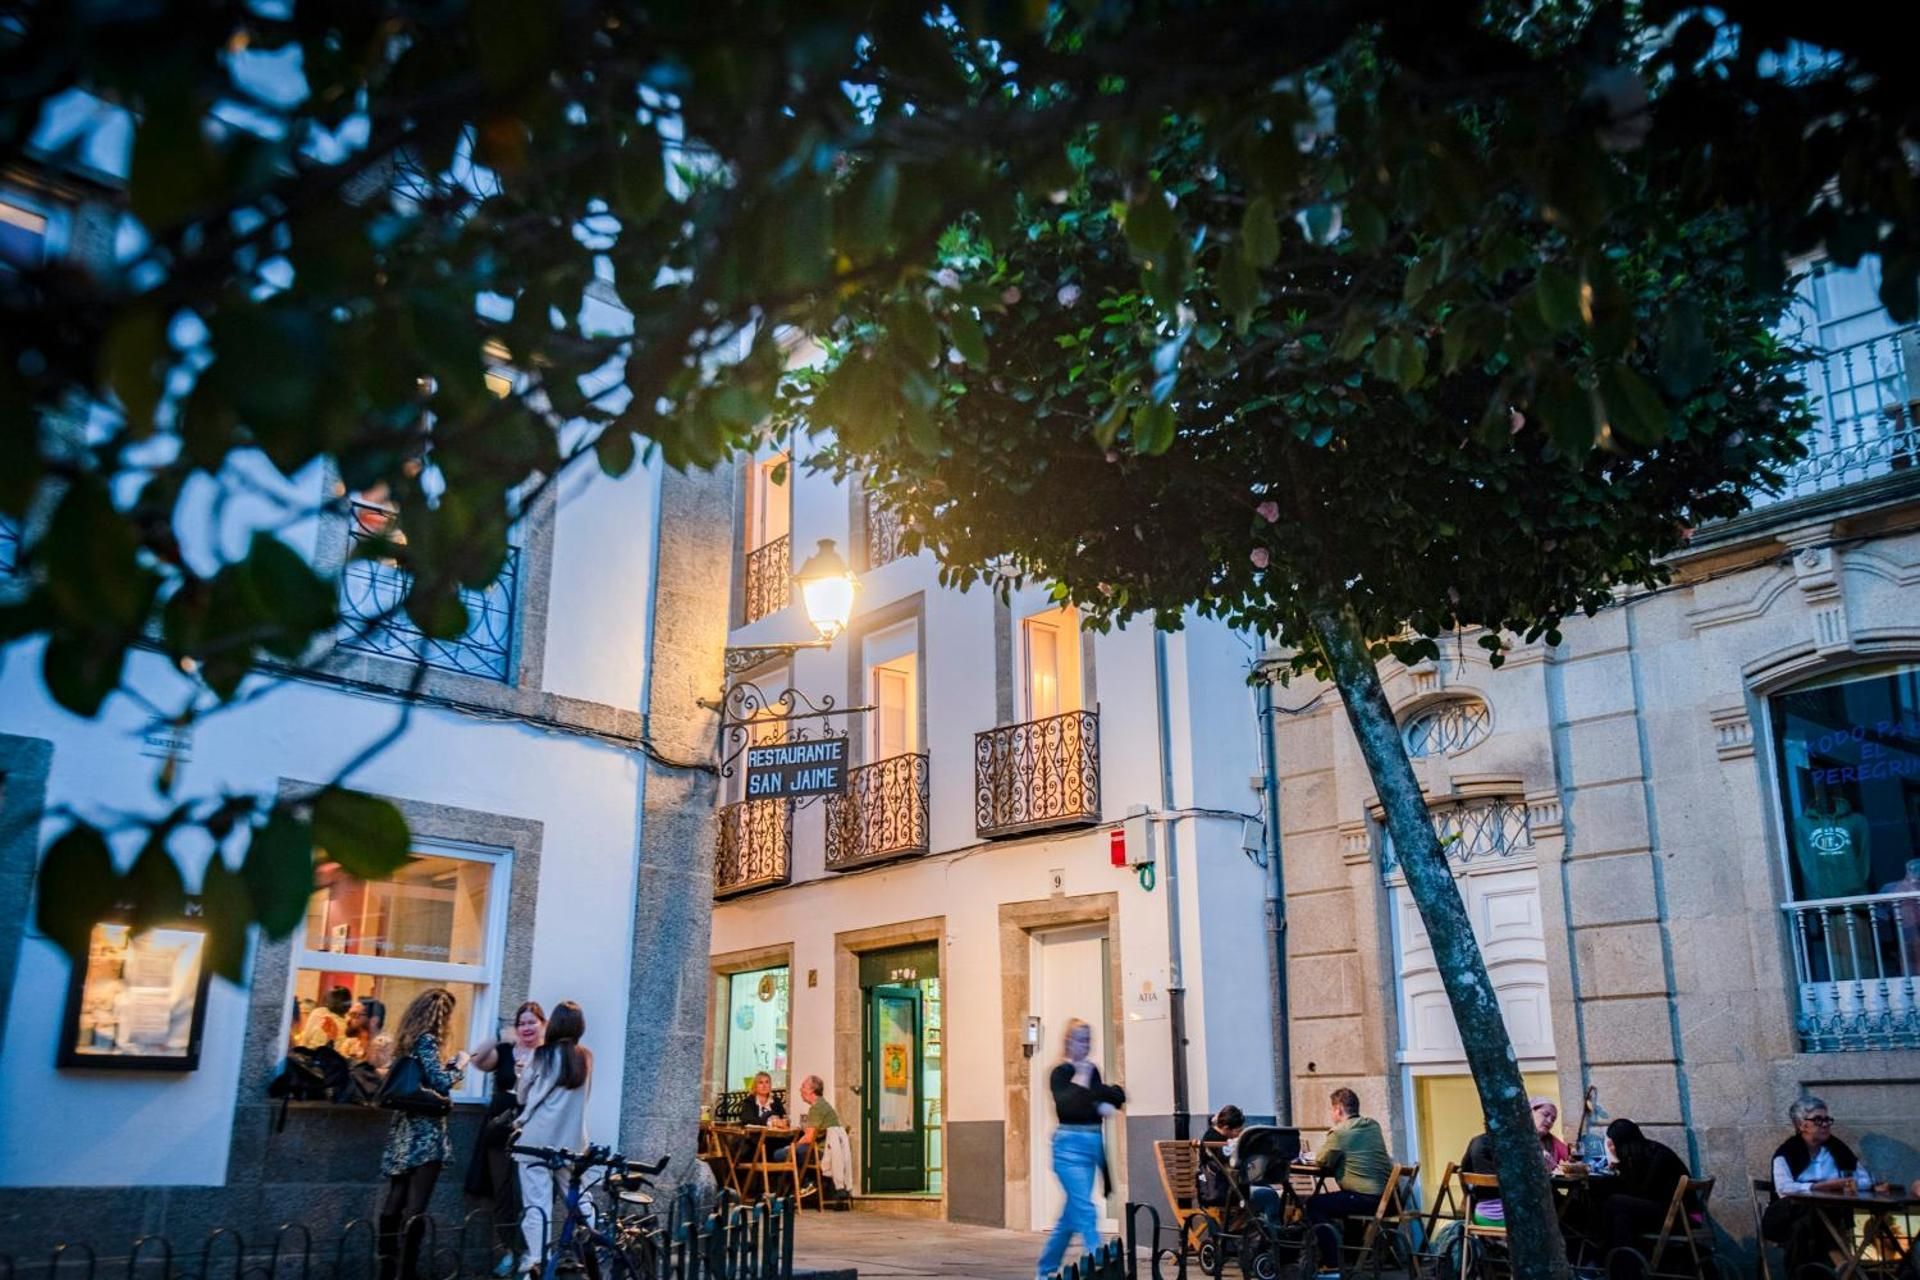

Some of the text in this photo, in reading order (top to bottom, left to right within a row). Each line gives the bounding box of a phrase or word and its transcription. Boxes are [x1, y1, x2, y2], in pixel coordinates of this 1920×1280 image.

[748, 742, 842, 767] RESTAURANTE
[1861, 743, 1887, 760] EL
[750, 767, 838, 794] SAN JAIME
[1054, 875, 1062, 889] 9
